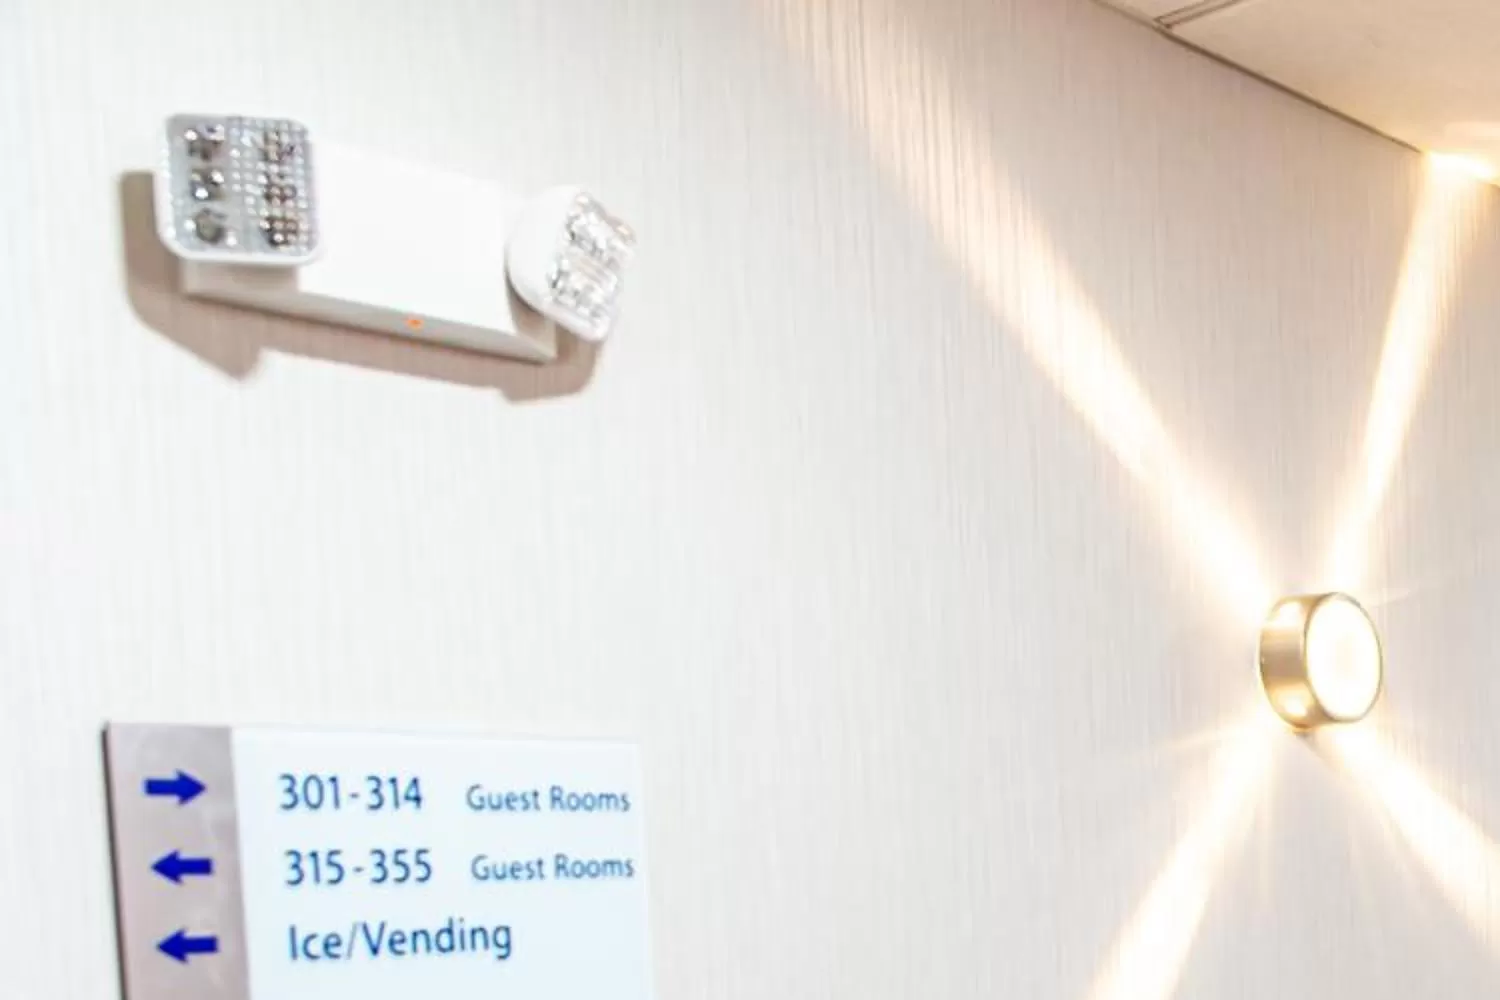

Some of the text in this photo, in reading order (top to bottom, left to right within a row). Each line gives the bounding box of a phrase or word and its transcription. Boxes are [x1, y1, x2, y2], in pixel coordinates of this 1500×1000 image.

[279, 773, 631, 812] 301-314 Guest Rooms
[285, 848, 635, 887] 315-355 Guest Rooms
[288, 917, 513, 962] Ice/Vending
